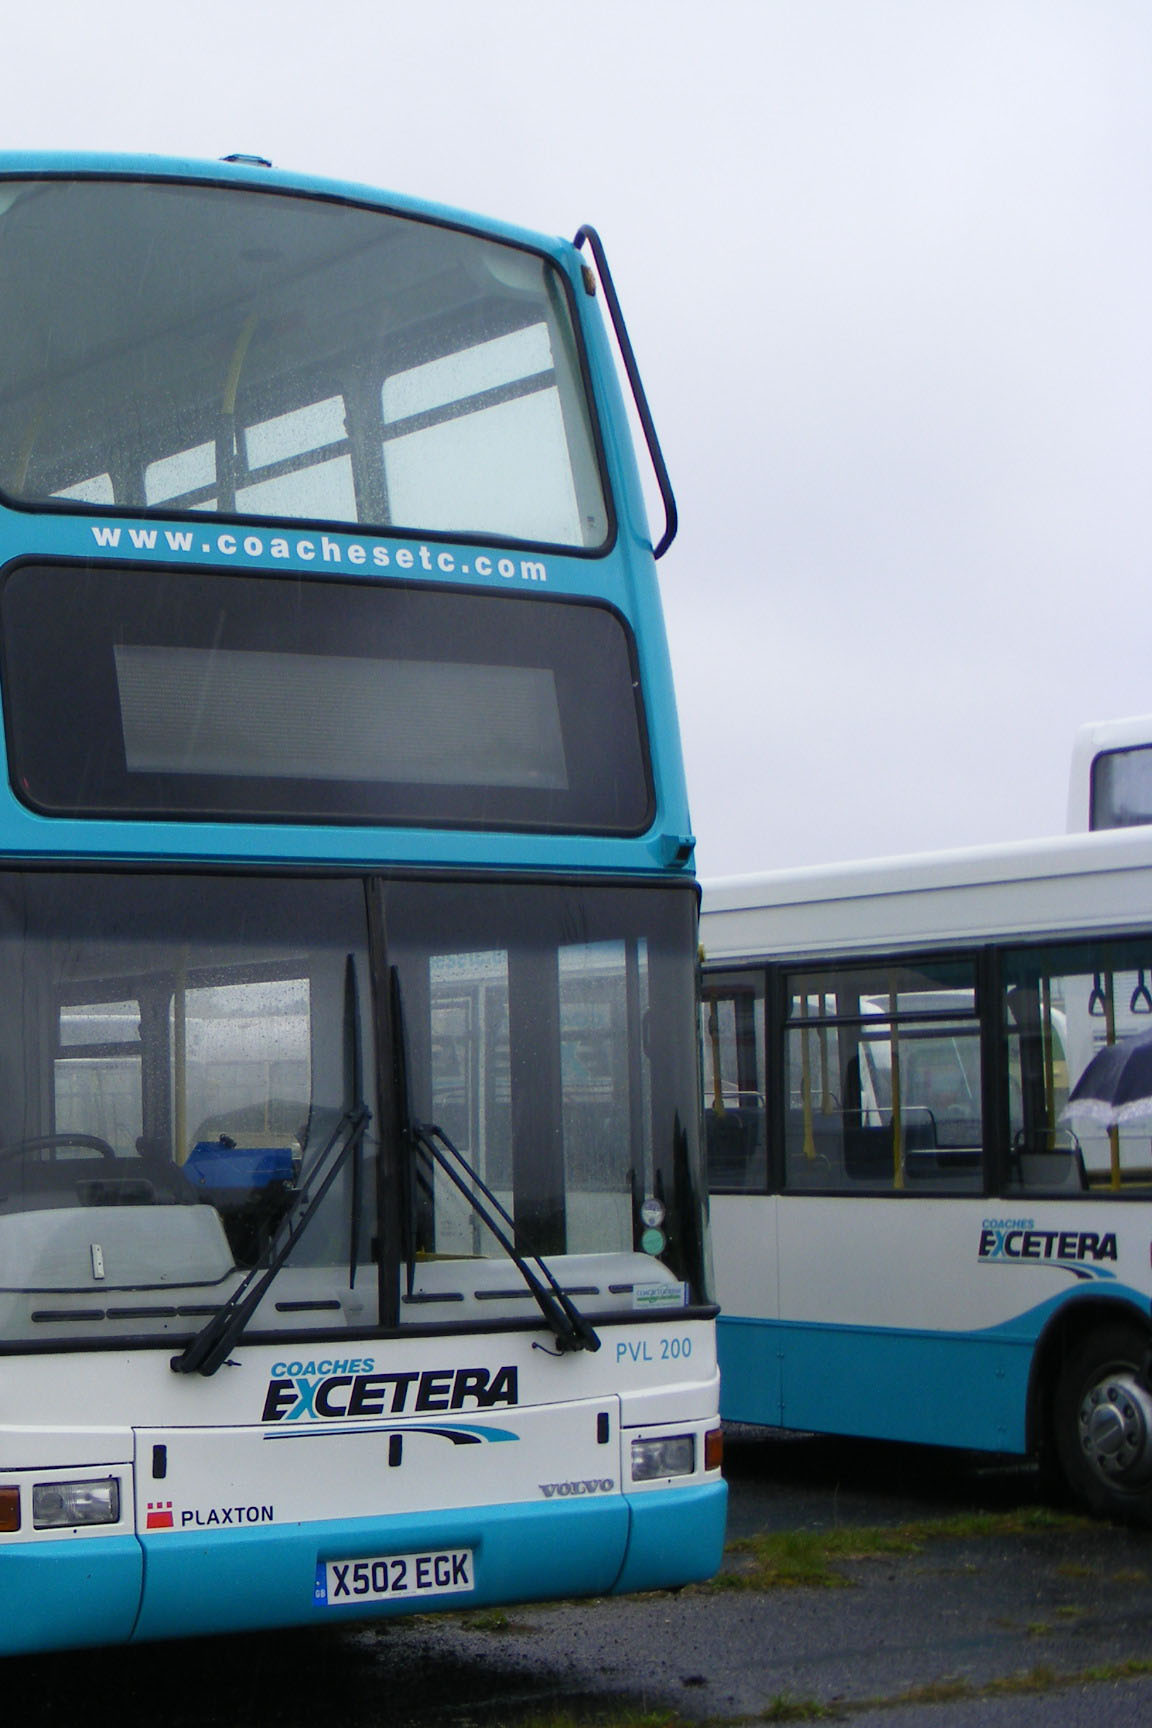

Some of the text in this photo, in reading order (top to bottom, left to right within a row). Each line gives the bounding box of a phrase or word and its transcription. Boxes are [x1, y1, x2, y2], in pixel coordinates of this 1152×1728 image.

[92, 526, 547, 581] www.coachesetc.com
[982, 1219, 1035, 1230] COACHES
[978, 1230, 1117, 1261] EXCETERA
[616, 1337, 692, 1363] PVL 200
[271, 1358, 375, 1377] COACHES
[262, 1366, 518, 1422] EXCETERA
[538, 1478, 614, 1498] VOLVO
[181, 1505, 274, 1527] PLAXTON
[332, 1553, 469, 1597] X502 EGK
[315, 1589, 326, 1598] GB
